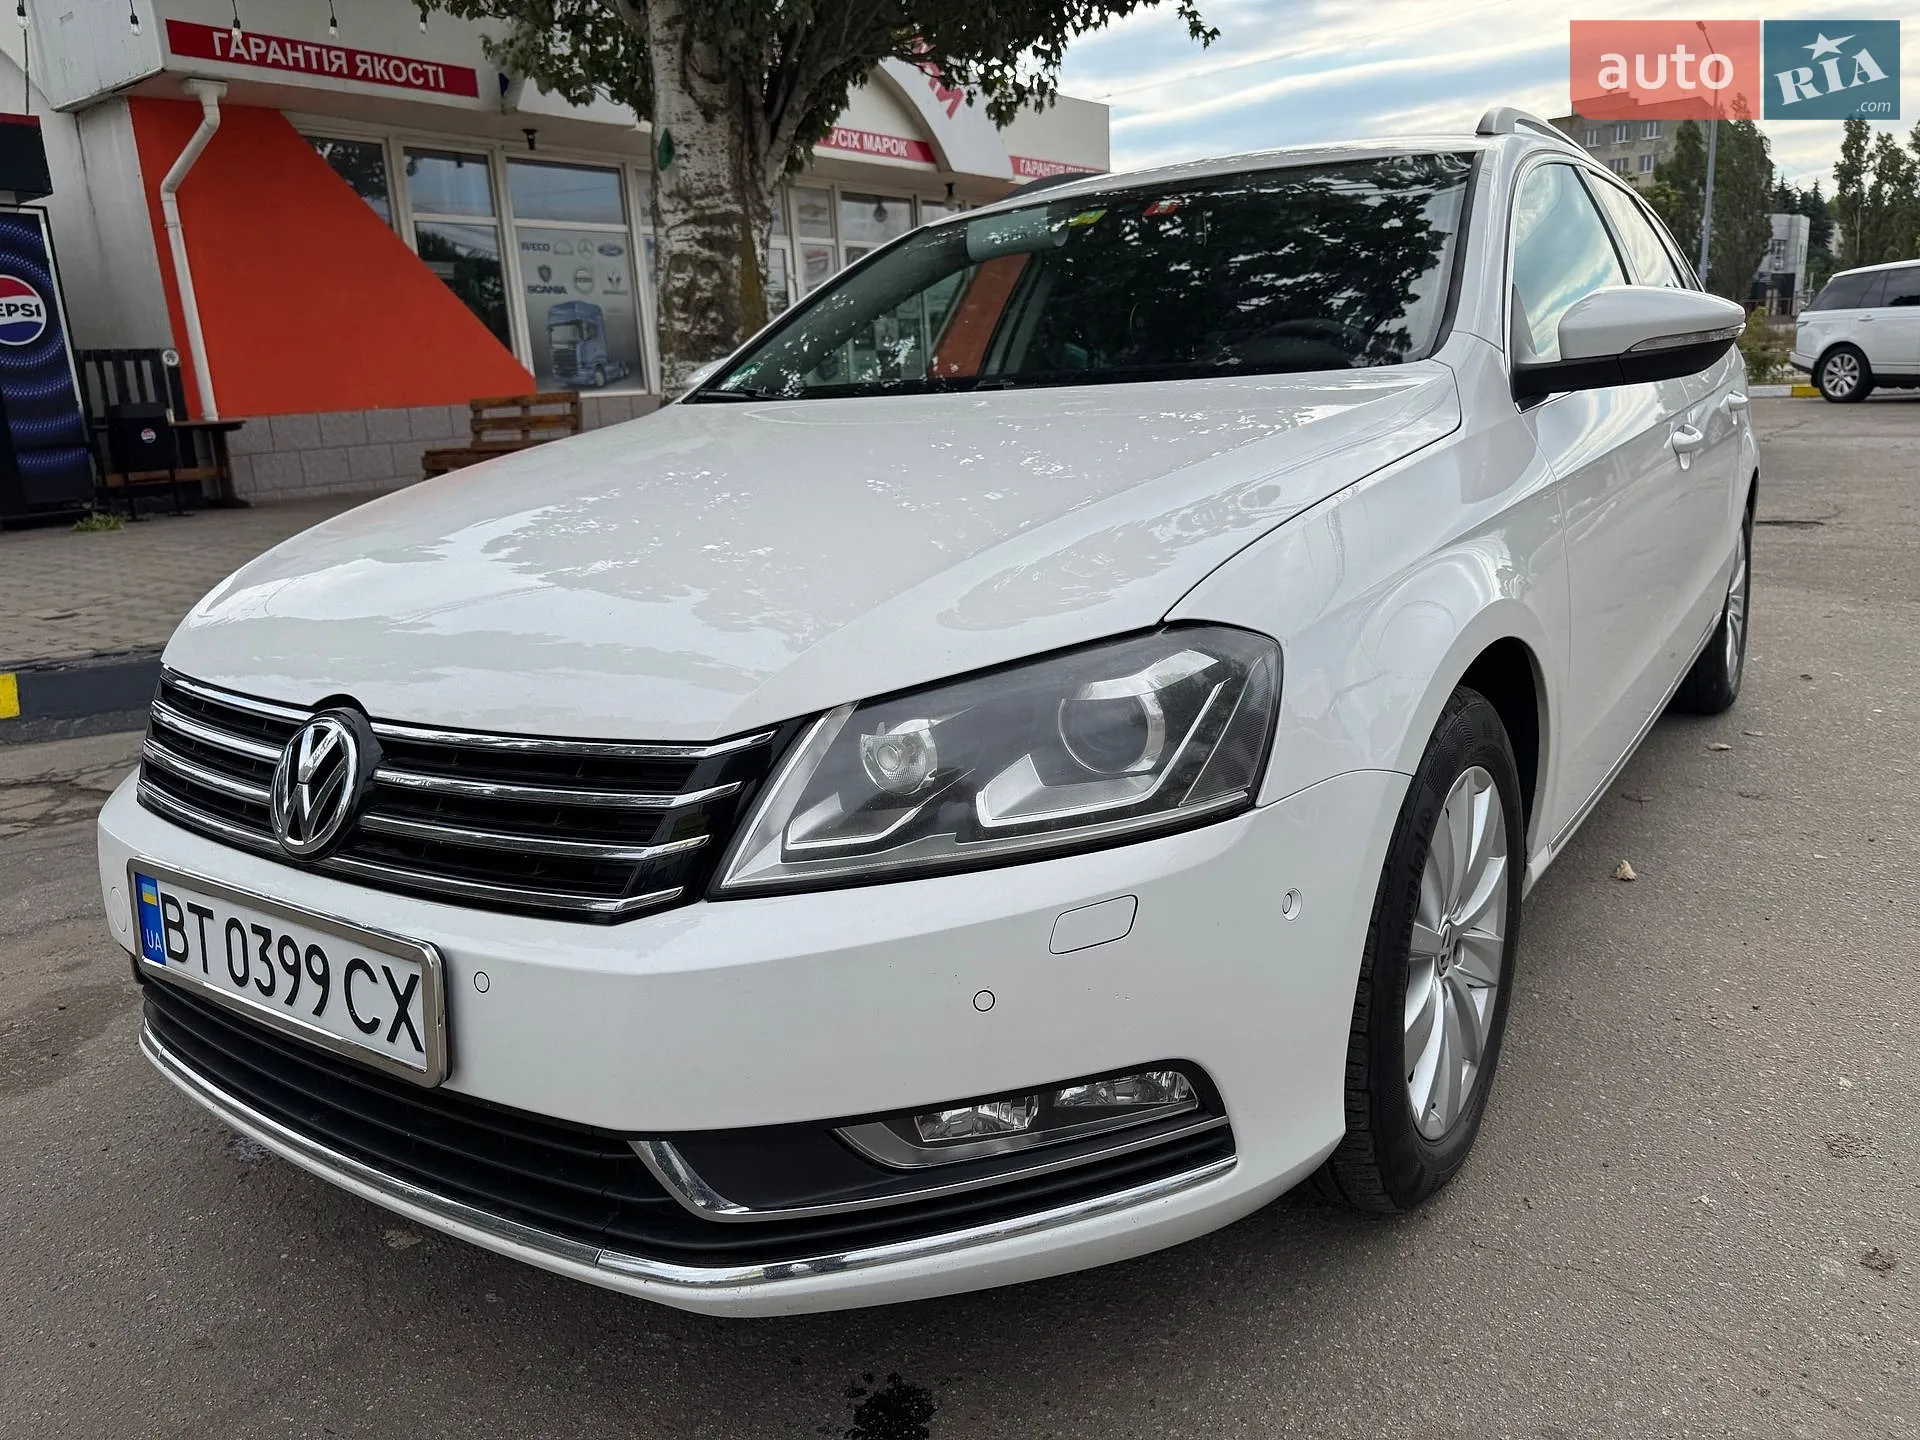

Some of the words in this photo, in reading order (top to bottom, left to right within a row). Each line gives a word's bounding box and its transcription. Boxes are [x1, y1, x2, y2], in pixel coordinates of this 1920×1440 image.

[212, 31, 348, 75] ГАРАНТІЯ
[355, 54, 445, 89] ЯКОСТІ
[863, 134, 908, 156] МАРОК
[521, 242, 551, 253] IVECO
[527, 285, 568, 295] SCANIA
[0, 303, 41, 317] EPSI
[145, 928, 163, 953] UA
[160, 891, 214, 974] BT
[224, 917, 331, 1017] 0399
[343, 958, 425, 1053] CX
